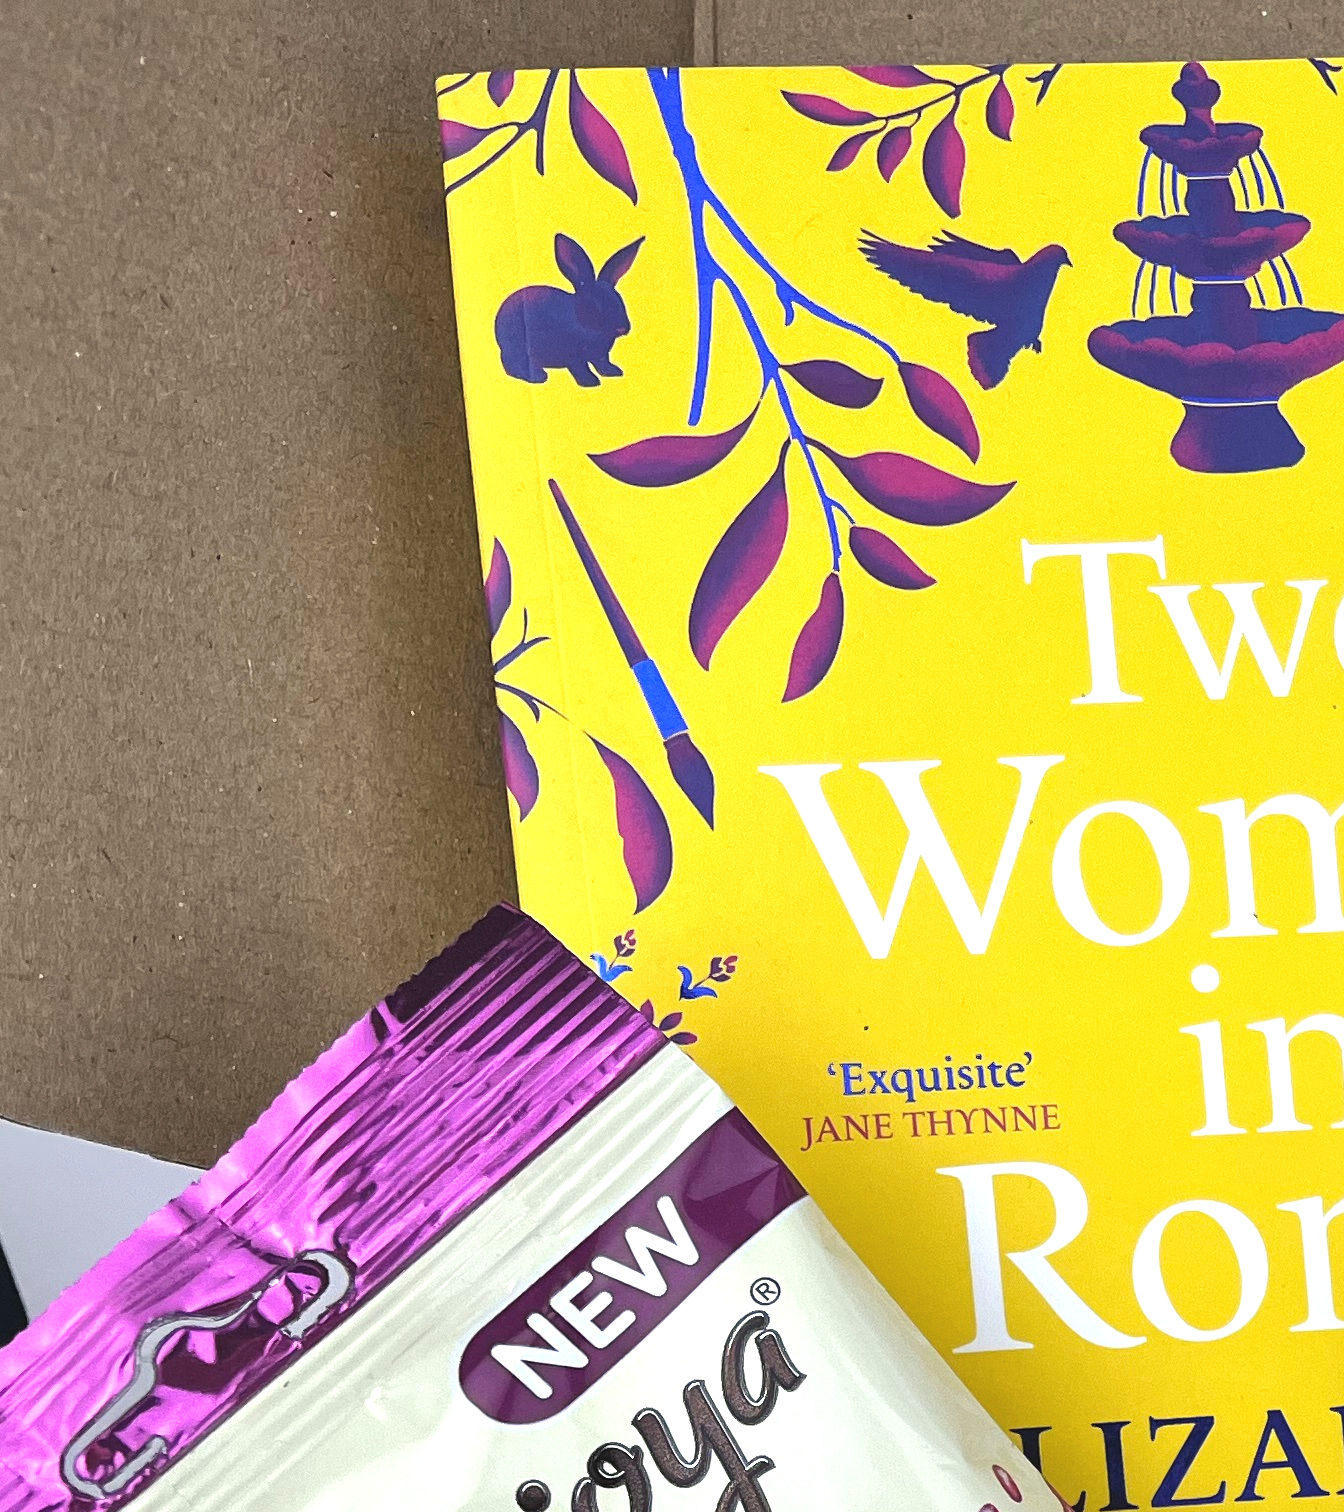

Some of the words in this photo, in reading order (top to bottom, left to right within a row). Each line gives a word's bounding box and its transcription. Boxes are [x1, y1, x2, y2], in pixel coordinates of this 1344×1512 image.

[800, 1113, 893, 1151] JANE
[903, 1105, 1061, 1138] THYNNE
[490, 1194, 703, 1400] NEW
